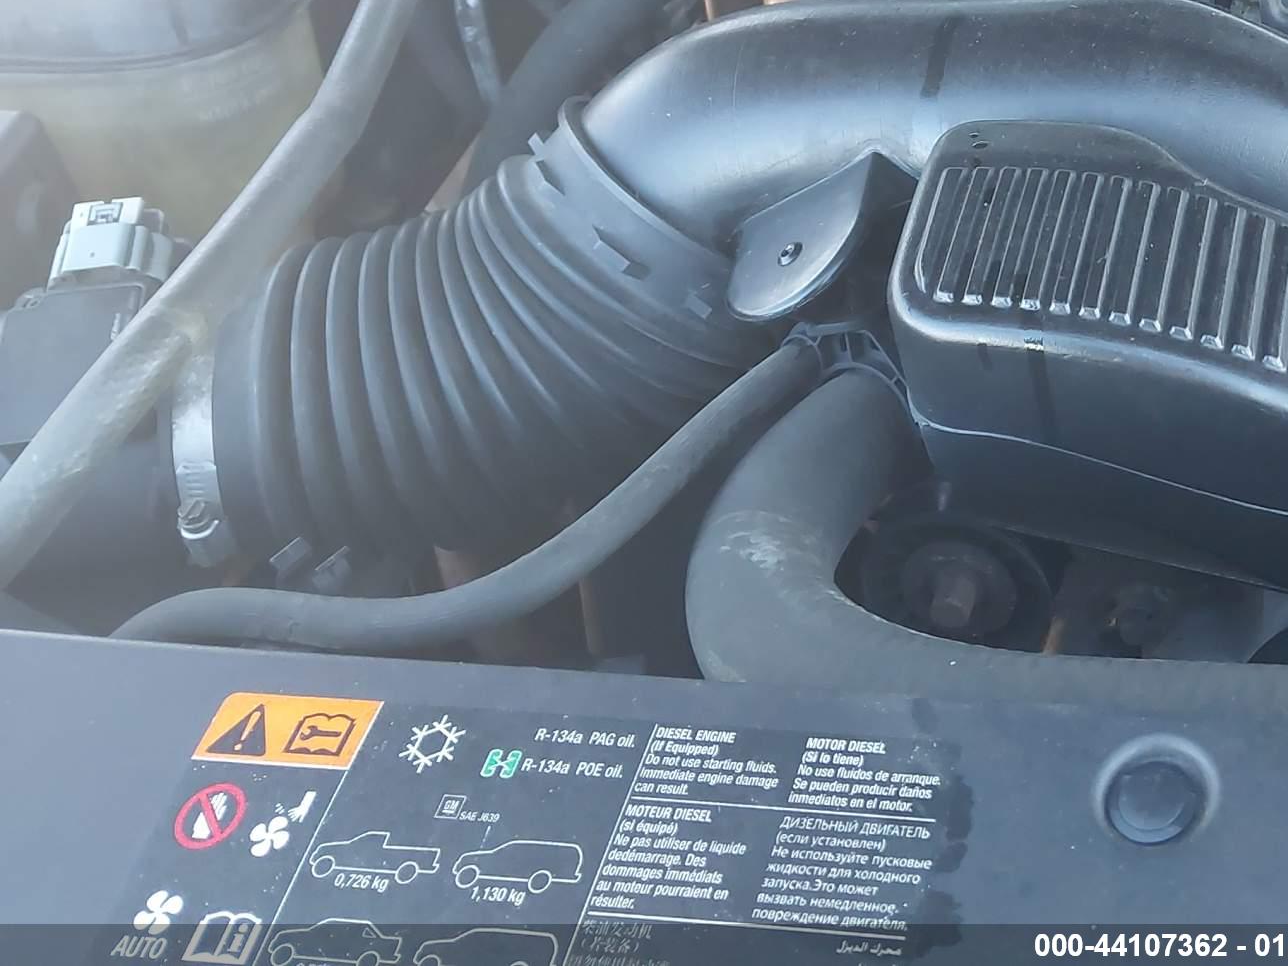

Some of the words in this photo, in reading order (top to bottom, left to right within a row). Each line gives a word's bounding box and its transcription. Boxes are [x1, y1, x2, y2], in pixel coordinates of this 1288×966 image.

[534, 728, 583, 744] R-134a
[588, 731, 616, 746] PAG
[617, 735, 635, 748] oil.
[656, 727, 693, 740] DIESEL
[695, 730, 736, 743] ENGINE
[665, 741, 719, 757] Equipped)
[806, 738, 847, 751] MOTOR
[848, 740, 886, 754] DIESEL
[521, 758, 571, 775] R-134a
[576, 762, 604, 777] POE
[604, 764, 623, 778] oil.
[645, 754, 660, 765] Do
[662, 756, 681, 766] not
[682, 758, 701, 768] use
[703, 758, 743, 773] starting
[745, 761, 777, 774] fluids.
[802, 751, 816, 764] (Si
[819, 753, 831, 764] lo
[833, 754, 864, 768] tiene)
[640, 767, 695, 782] Immediate
[697, 773, 733, 786] engine
[735, 775, 779, 790] damage
[797, 765, 813, 776] No
[815, 767, 834, 778] use
[837, 768, 873, 780] fluidos
[875, 770, 889, 782] de
[891, 774, 941, 788] arranque.
[634, 783, 654, 794] can
[656, 783, 689, 795] result.
[793, 778, 807, 789] Se
[809, 780, 850, 793] pueden
[851, 782, 896, 796] producir
[899, 785, 932, 799] daños
[444, 800, 461, 810] GM
[788, 792, 848, 807] inmediatos
[850, 798, 865, 808] en
[866, 798, 876, 809] el
[879, 800, 913, 812] motor.
[459, 811, 478, 821] SAE
[477, 812, 501, 823] J639
[625, 804, 671, 820] MOTEUR
[673, 807, 712, 822] DIESEL
[620, 819, 634, 833] (si
[636, 820, 678, 836] équipé)
[780, 816, 859, 834] ДИЗЕЛЬНЫЙ
[860, 822, 931, 839] ДВИГАТЕЛЬ
[614, 834, 628, 846] Ne
[630, 837, 651, 849] pas
[654, 837, 691, 851] utiliser
[693, 840, 707, 852] de
[709, 841, 746, 856] liquide
[776, 831, 808, 845] (если
[811, 834, 886, 852] установлен)
[608, 849, 682, 867] dedémarrage.
[685, 854, 707, 867] Des
[771, 846, 789, 858] Не
[791, 848, 869, 865] используйте
[872, 855, 932, 870] пусковые
[334, 873, 371, 889] 0,726
[371, 876, 389, 893] kg
[602, 864, 662, 881] dommages
[665, 868, 723, 884] immédiats
[766, 862, 827, 877] жидкости
[828, 868, 851, 879] для
[854, 870, 921, 885] холодного
[471, 885, 507, 902] 1,130
[507, 888, 526, 906] kg
[596, 880, 611, 891] au
[613, 882, 654, 894] moteur
[654, 885, 712, 899] pourraient
[713, 889, 729, 900] en
[757, 893, 807, 907] вызвать
[837, 884, 879, 896] может
[590, 895, 634, 909] résulter.
[752, 908, 839, 925] повреждение
[841, 916, 908, 931] двигателя.
[110, 935, 167, 959] AUTO
